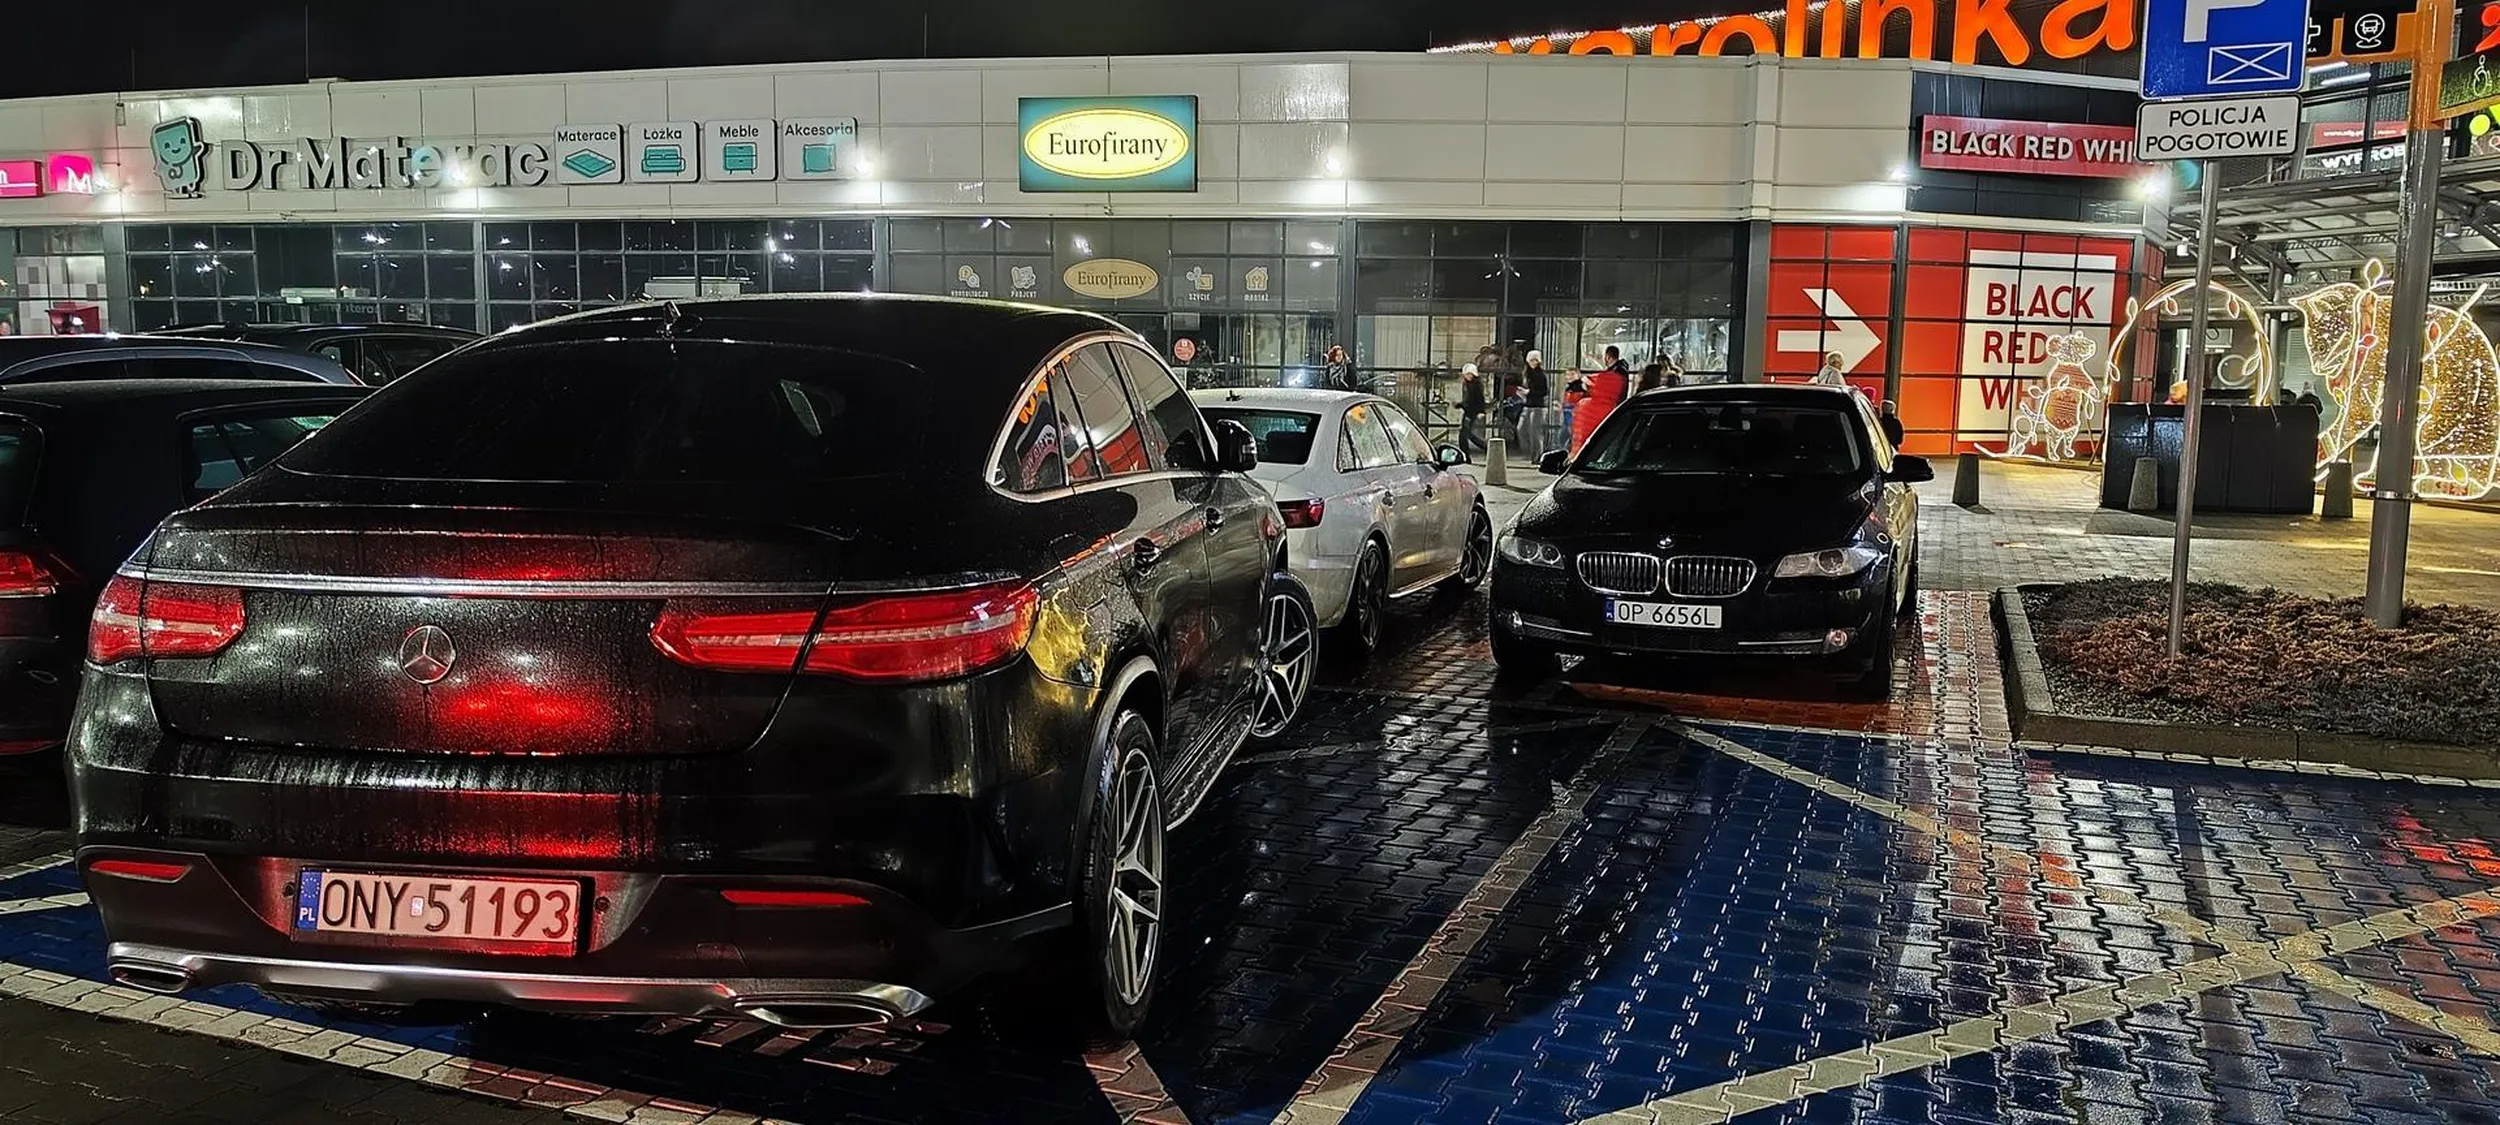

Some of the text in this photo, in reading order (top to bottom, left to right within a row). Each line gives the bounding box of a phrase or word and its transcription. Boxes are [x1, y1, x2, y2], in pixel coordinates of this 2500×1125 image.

[2169, 107, 2266, 128] POLICJA
[557, 130, 618, 143] Materace
[719, 125, 759, 138] Meble
[785, 122, 854, 138] Akcesoria
[1049, 132, 1168, 162] Eurofirany
[1932, 130, 2015, 158] BLACK
[2023, 136, 2074, 160] RED
[2146, 130, 2288, 154] POGOTOWIE
[221, 139, 285, 190] Dr
[1078, 271, 1147, 291] Eurofirany
[1986, 282, 2095, 319] BLACK
[1983, 331, 2048, 365] RED
[1618, 603, 1716, 626] OP 6656L
[300, 907, 316, 922] PL
[321, 878, 571, 940] ONY 51193
